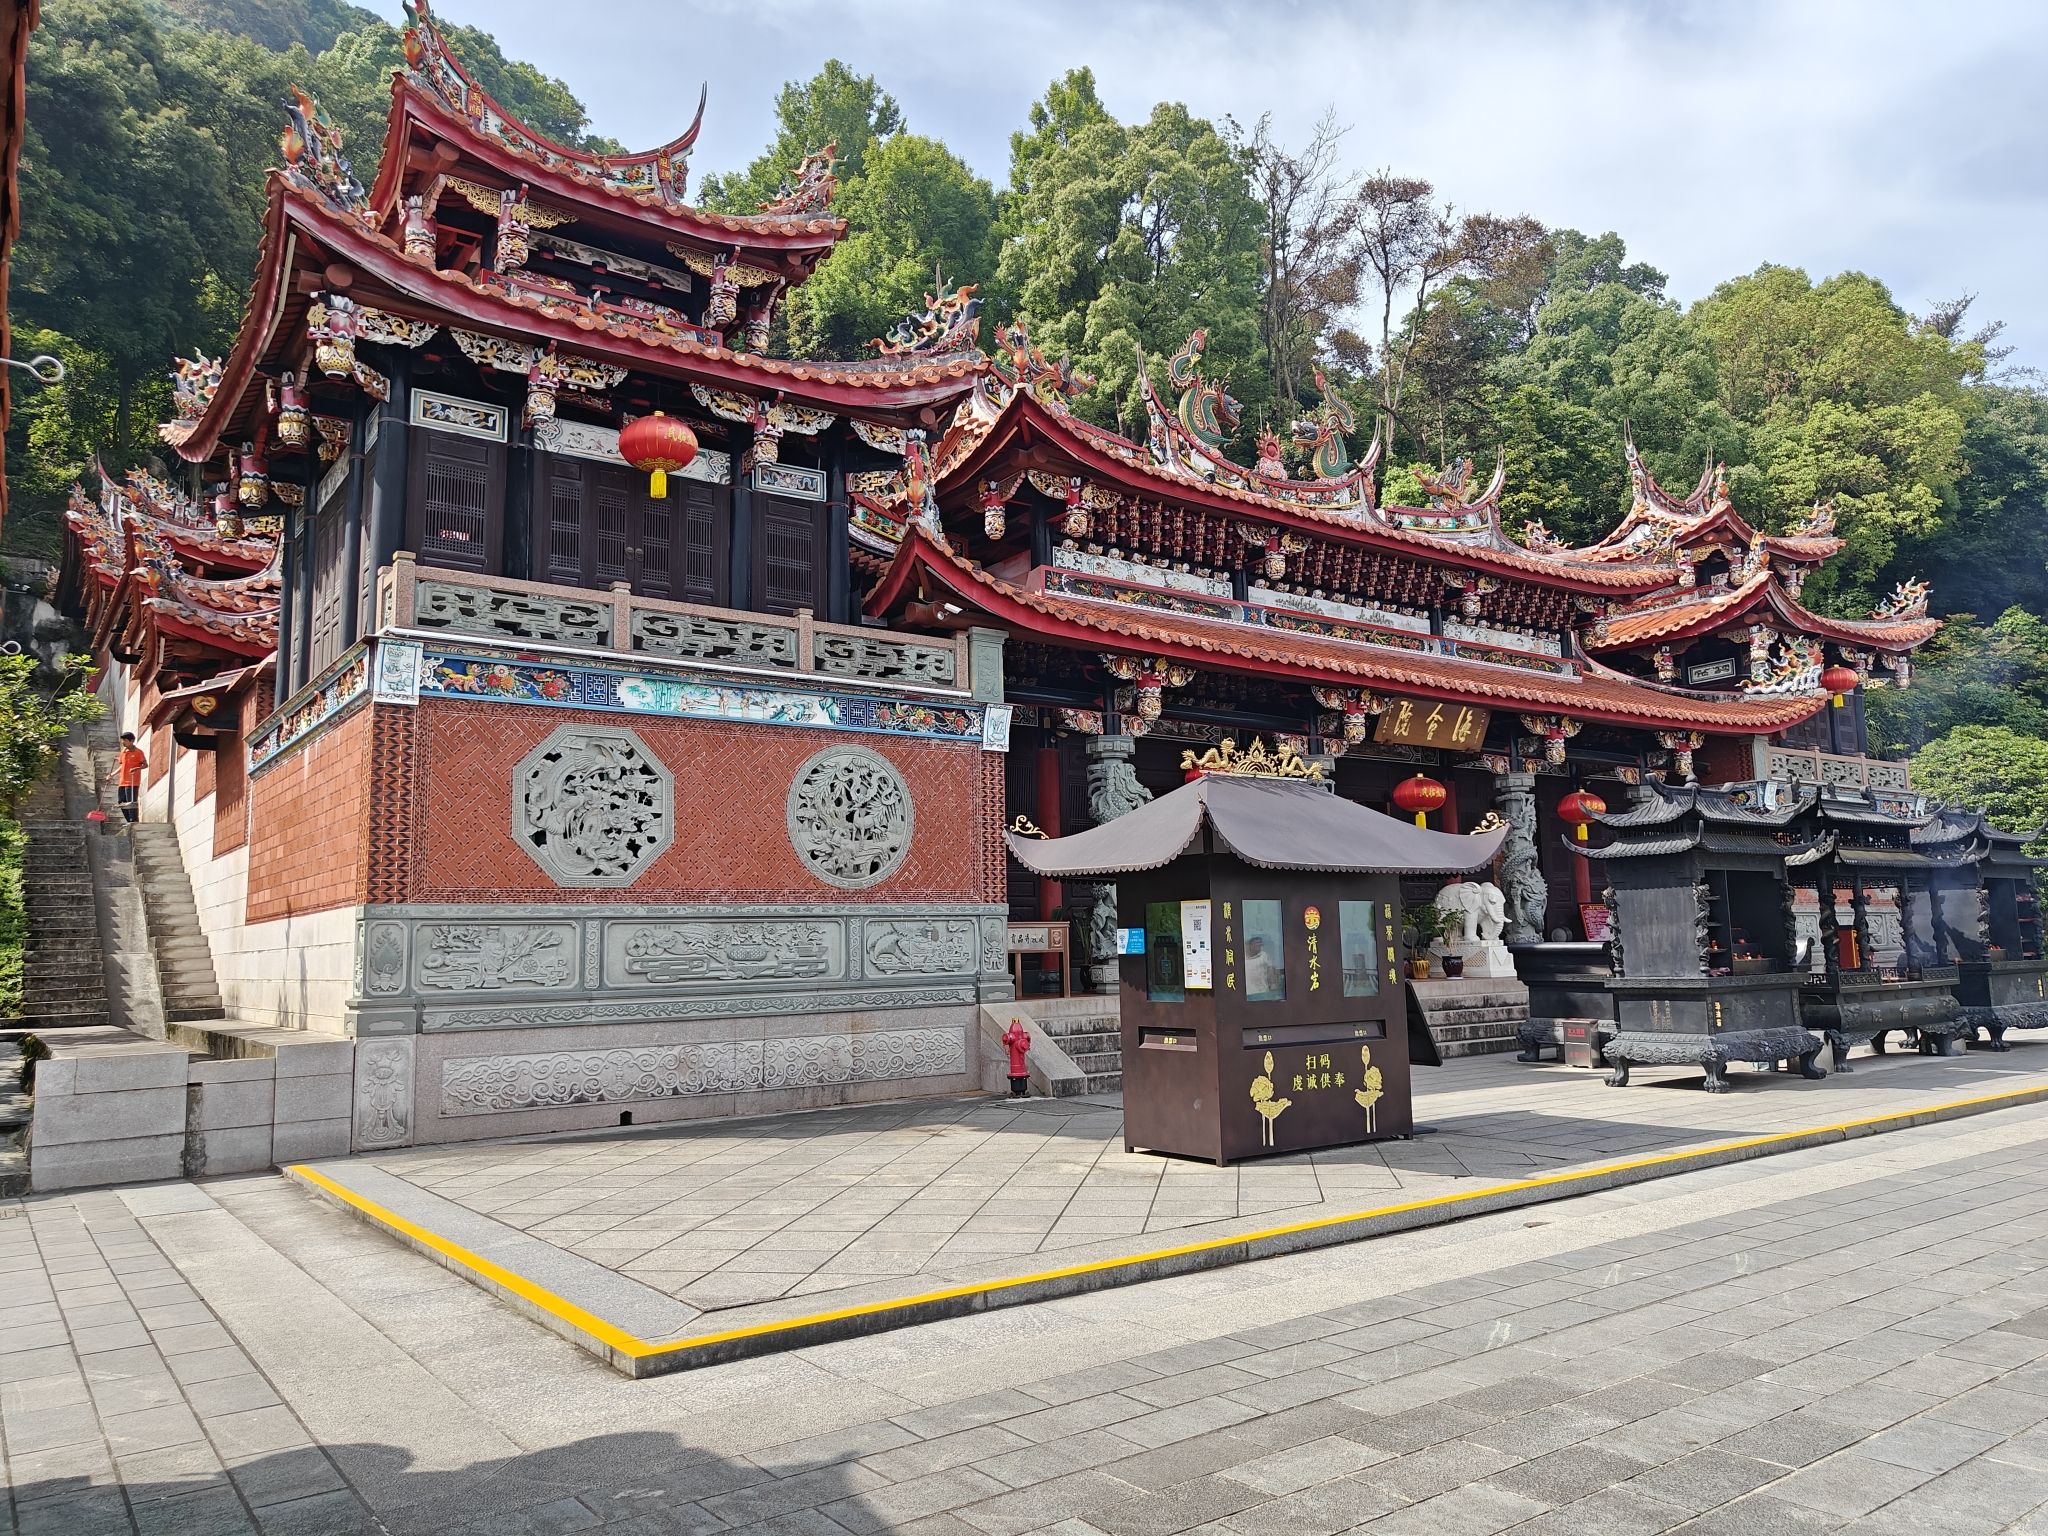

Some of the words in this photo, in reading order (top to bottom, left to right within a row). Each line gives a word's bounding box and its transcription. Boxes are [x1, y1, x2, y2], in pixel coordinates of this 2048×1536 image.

[1307, 932, 1321, 991] 清水岩
[1305, 1053, 1331, 1070] 扫码
[1292, 1071, 1346, 1092] 虔诚供奉
